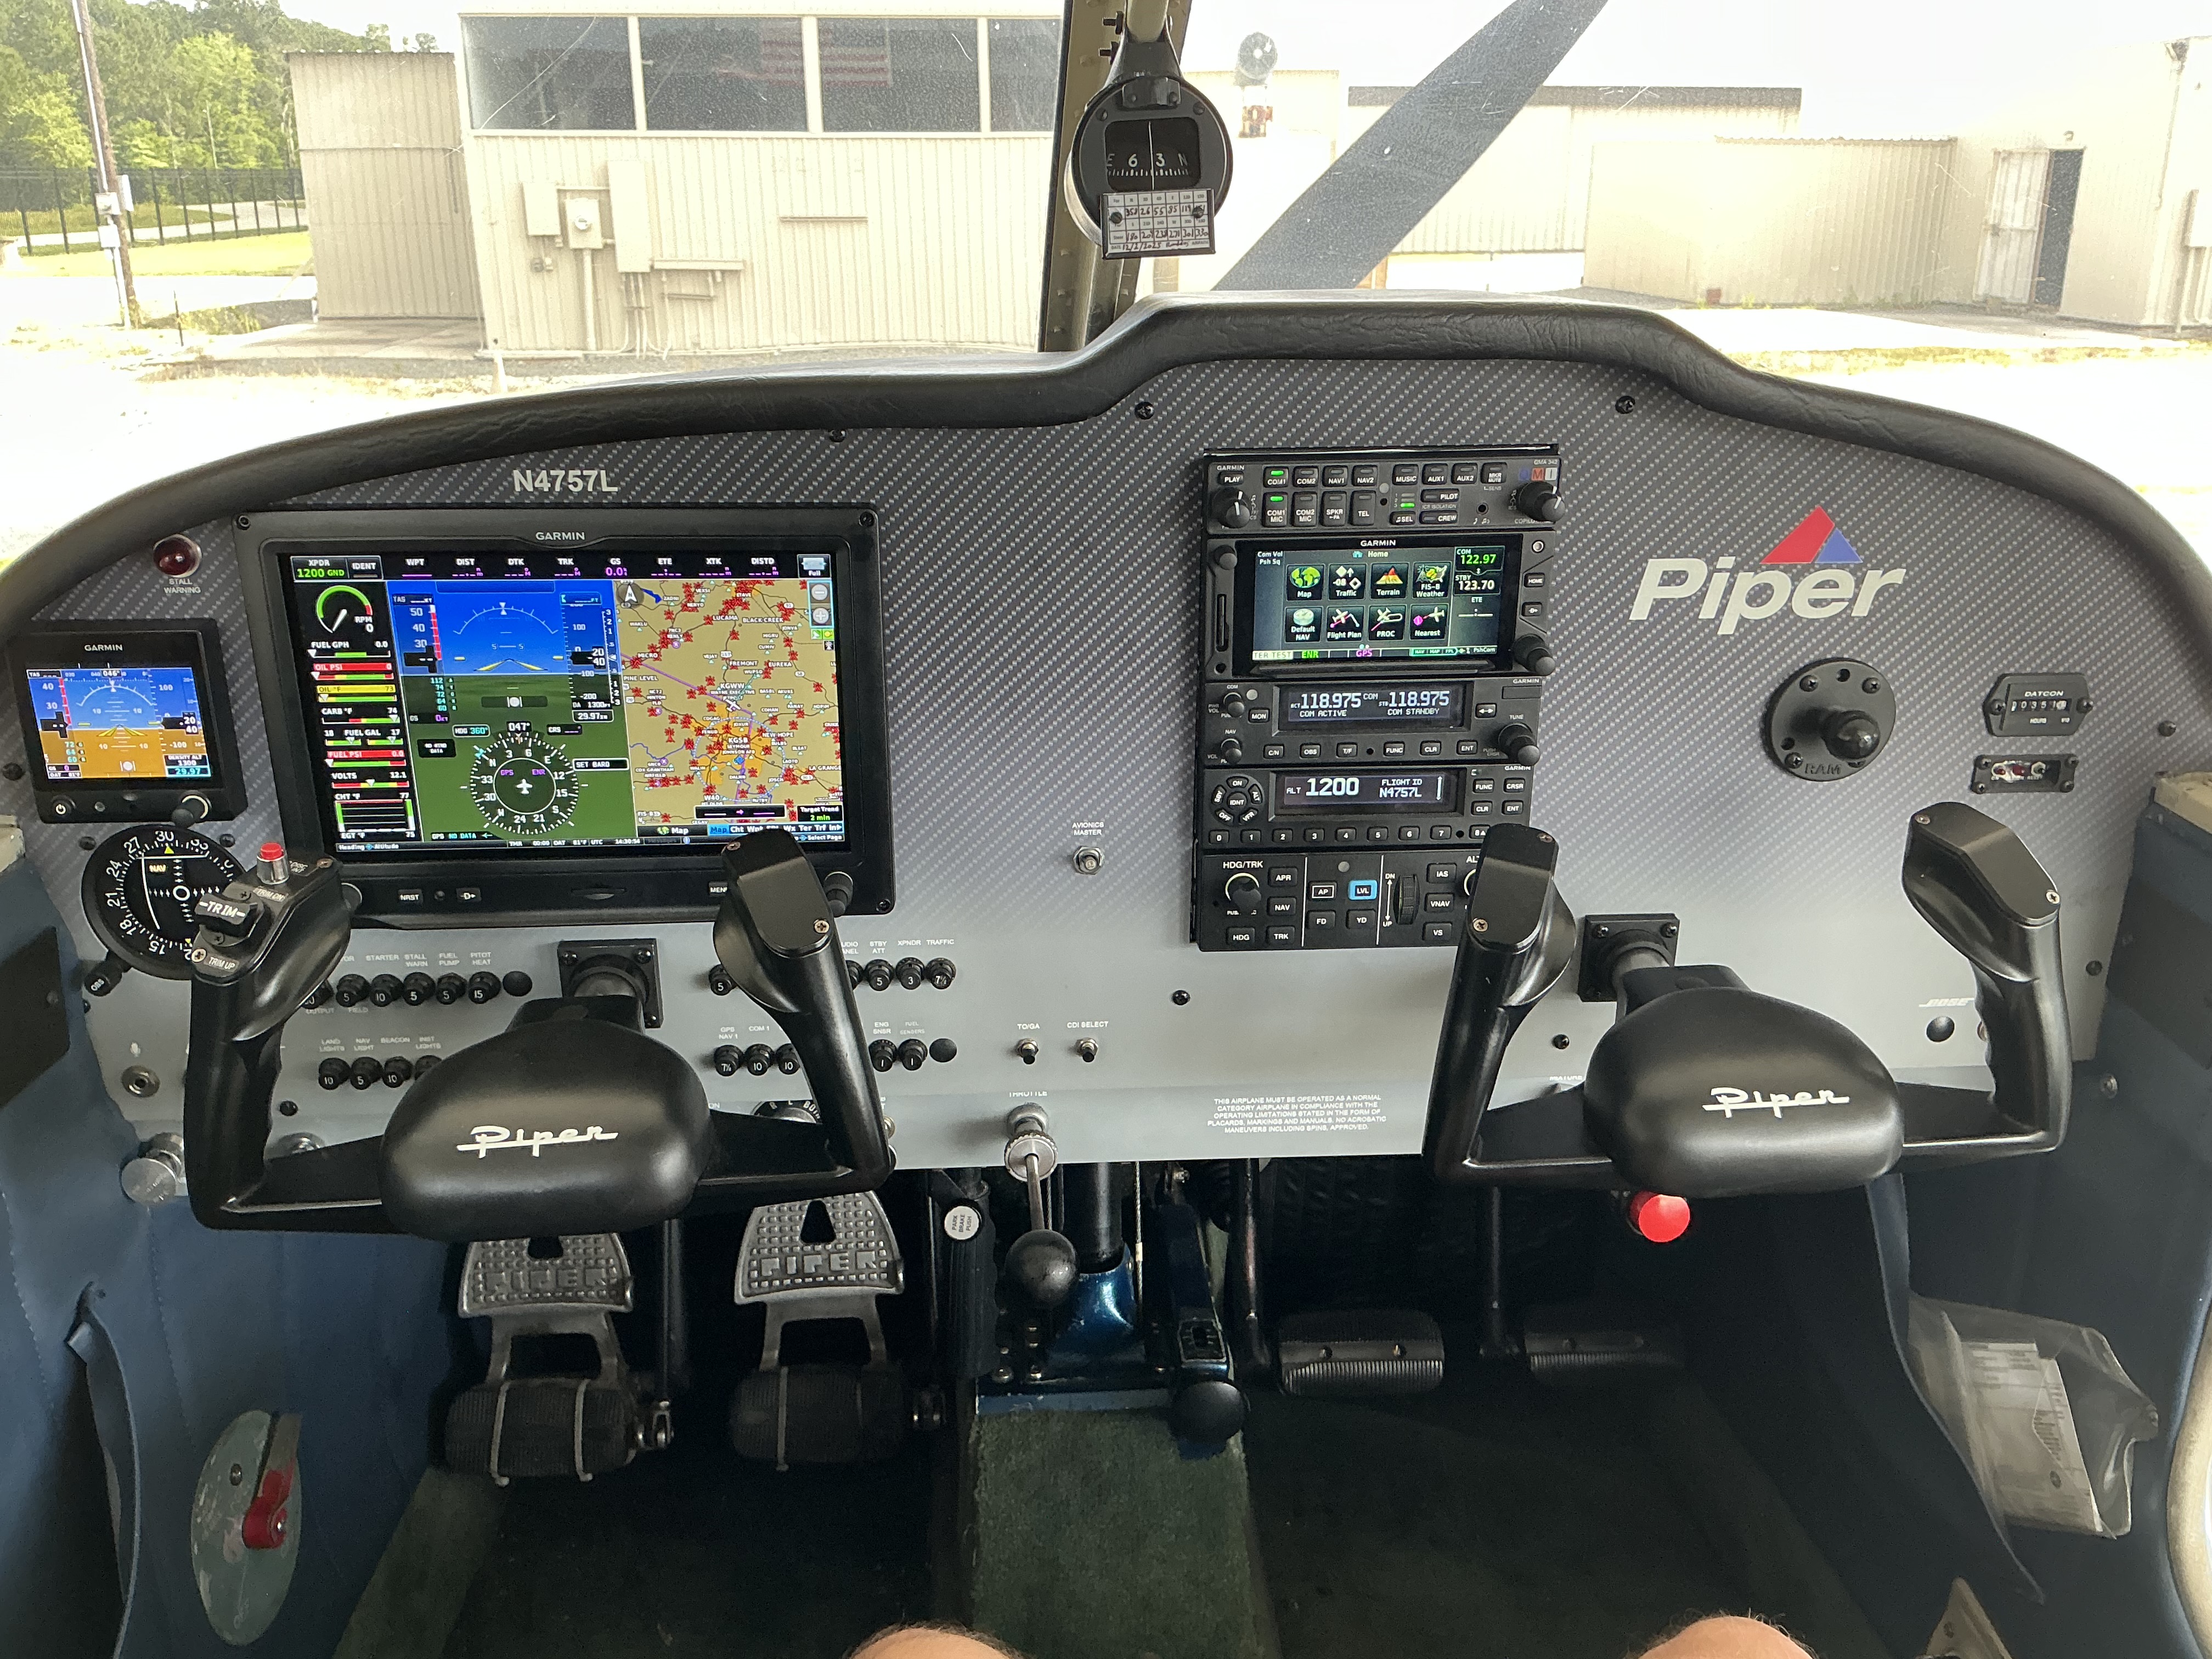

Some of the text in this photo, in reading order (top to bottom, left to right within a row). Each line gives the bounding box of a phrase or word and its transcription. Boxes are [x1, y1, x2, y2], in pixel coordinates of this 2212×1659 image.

[1128, 155, 1137, 167] 6
[1156, 154, 1165, 167] 3
[1154, 207, 1165, 216] 55
[512, 470, 618, 492] N4757L
[535, 532, 585, 541] GARMIN
[1460, 554, 1496, 565] 122.97
[297, 569, 325, 578] 1200
[1458, 580, 1494, 590] 123.70
[1297, 590, 1312, 599] Map
[1629, 556, 1906, 635] Piper
[410, 608, 423, 617] 50
[413, 624, 425, 632] 40
[1327, 631, 1345, 640] Flight
[1301, 693, 1361, 708] 118.975
[1389, 691, 1449, 707] 118.975
[509, 723, 530, 731] 047°
[1306, 777, 1359, 795] 1200
[1379, 787, 1421, 798] N4757L
[156, 831, 174, 842] 30
[124, 837, 139, 853] 27
[106, 860, 121, 877] 24
[150, 864, 166, 872] NAV
[1222, 861, 1263, 870] HDG/TRK
[108, 892, 120, 907] 21
[1702, 1087, 1850, 1118] Piper
[456, 1124, 618, 1158] Piper
[760, 1250, 879, 1276] PIPER
